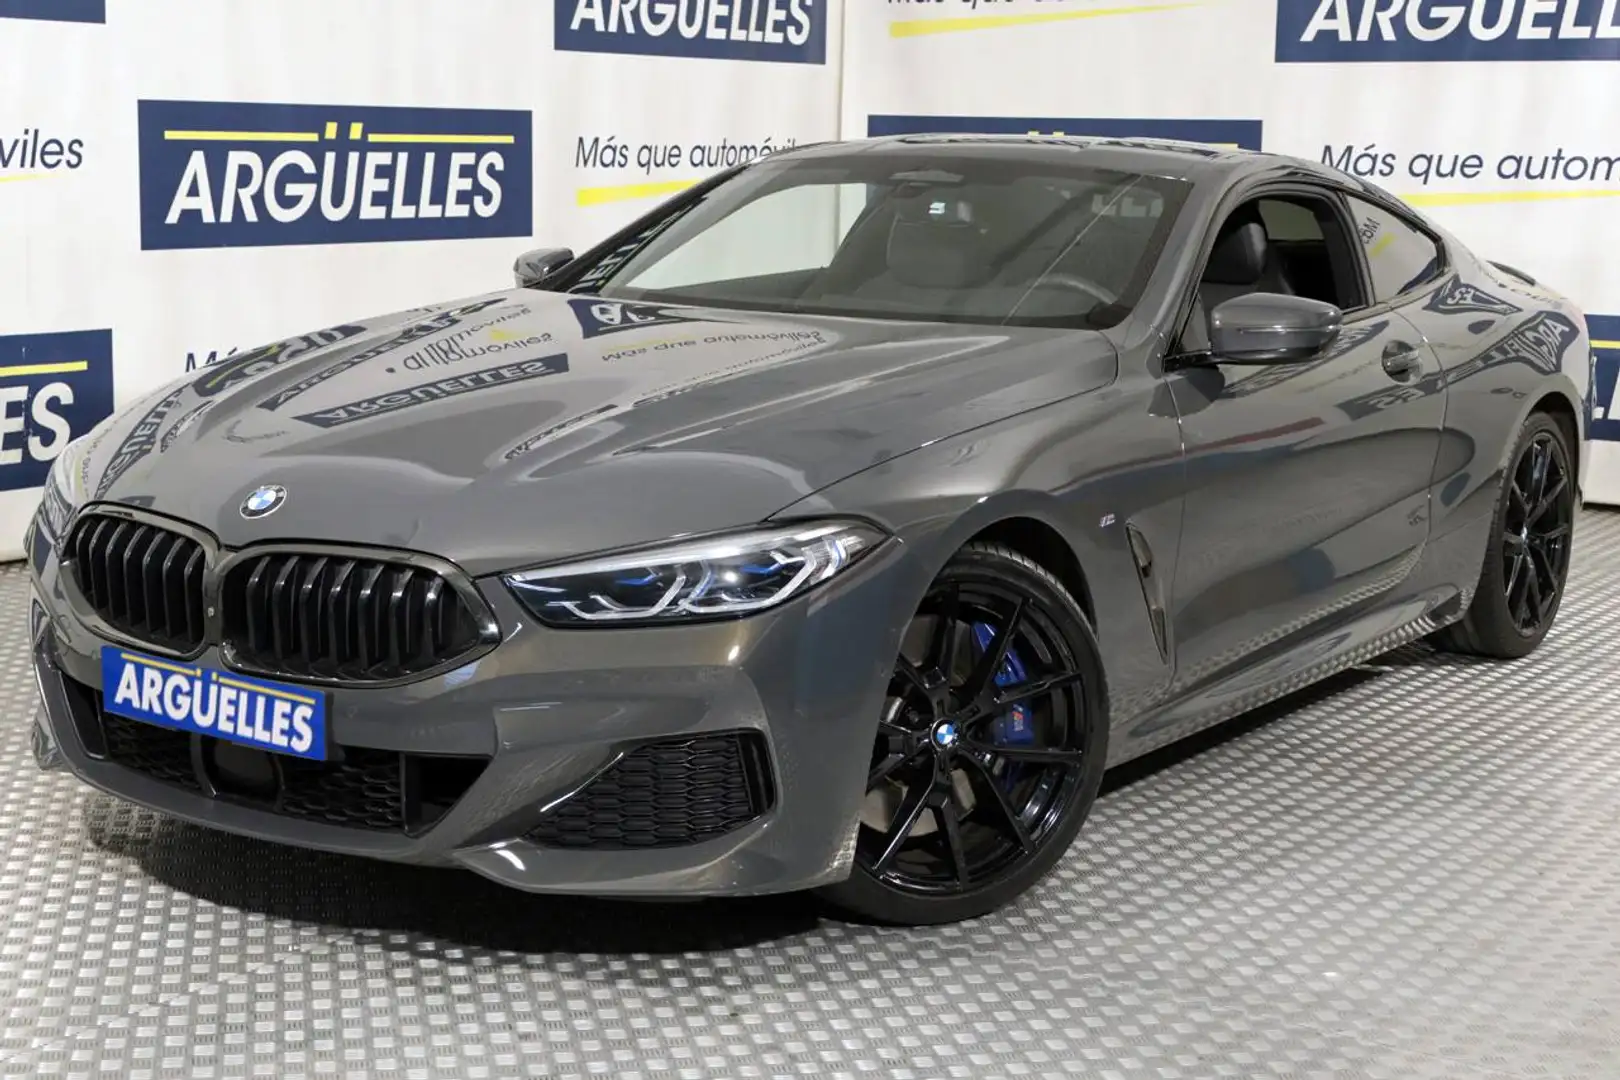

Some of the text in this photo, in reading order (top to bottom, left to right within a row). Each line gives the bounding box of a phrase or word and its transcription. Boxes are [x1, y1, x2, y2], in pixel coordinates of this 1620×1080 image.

[165, 122, 505, 224] ARGÜELLES
[575, 136, 628, 168] Más
[637, 145, 681, 175] que
[1321, 143, 1396, 177] Más
[1408, 153, 1484, 185] que
[114, 662, 313, 753] ARGÜELLES
